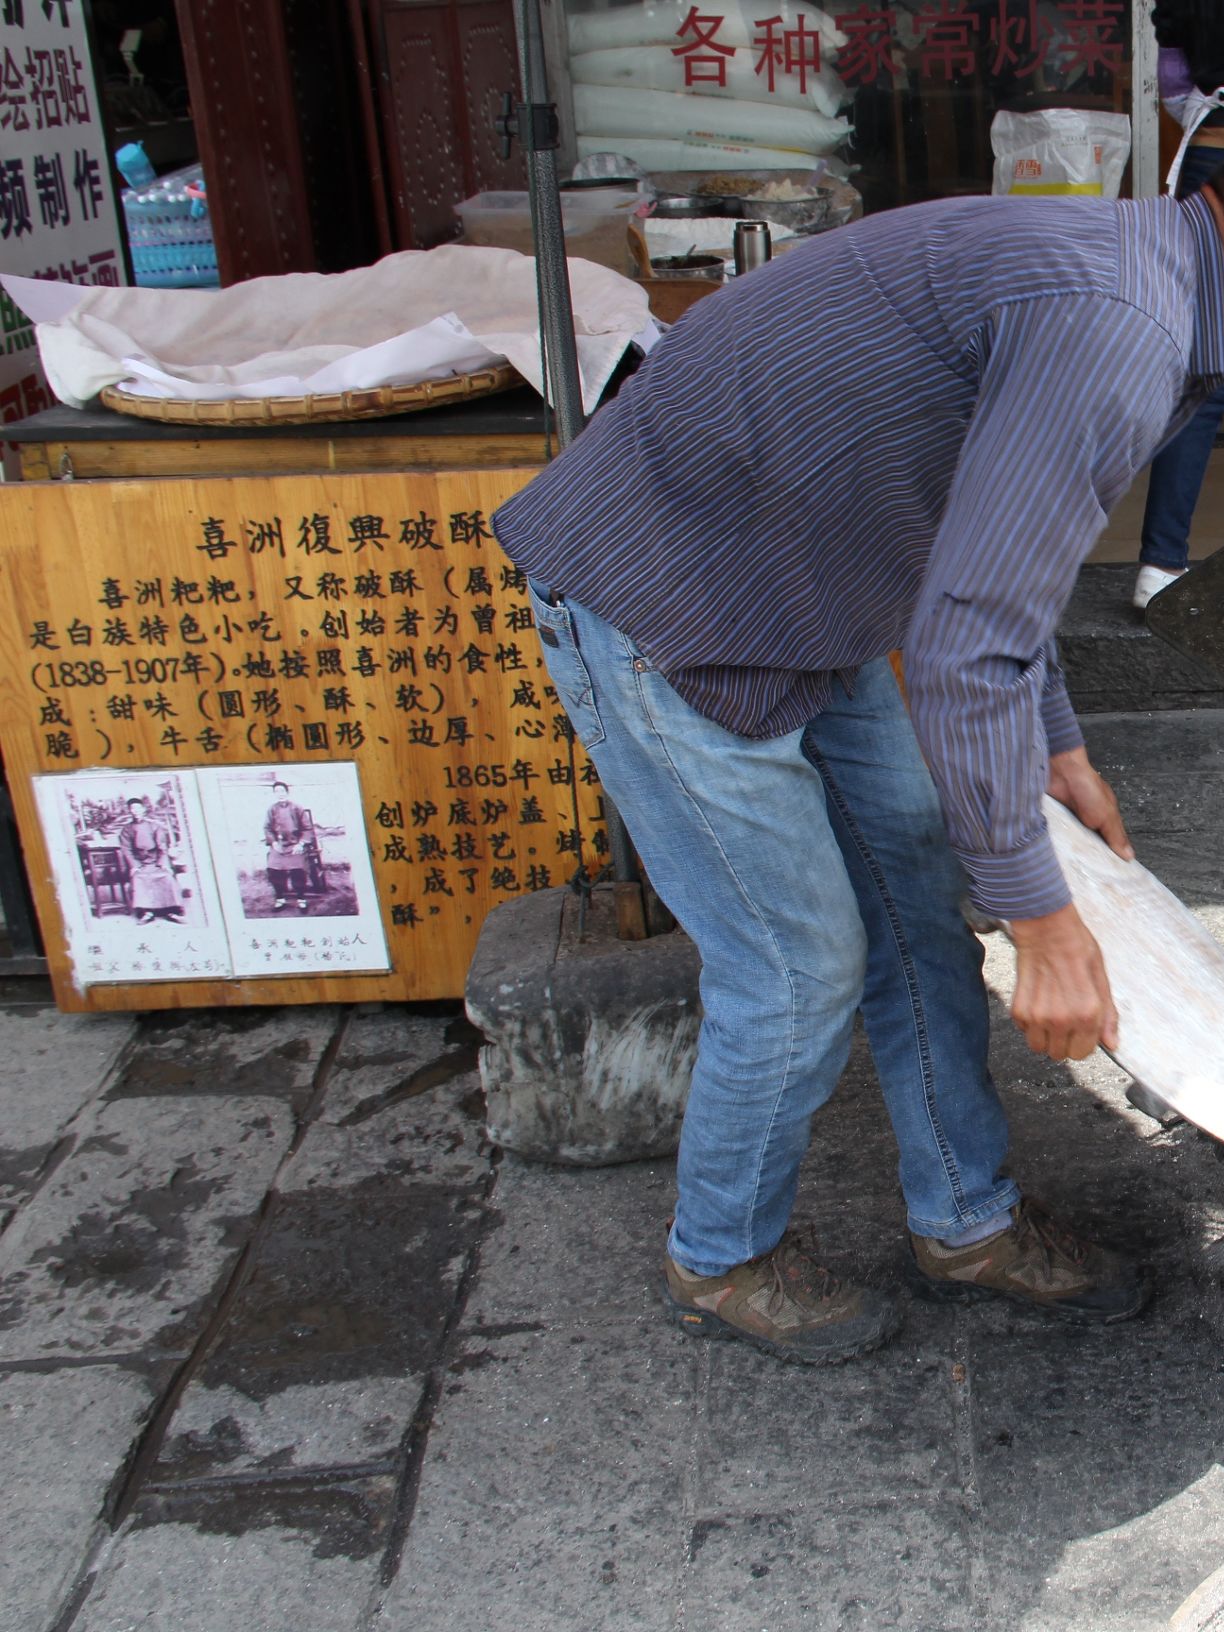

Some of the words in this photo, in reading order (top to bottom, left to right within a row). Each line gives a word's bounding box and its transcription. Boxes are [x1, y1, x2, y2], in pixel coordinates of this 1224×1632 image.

[671, 0, 1127, 94] 各种家常炒菜
[196, 509, 496, 560] 喜洲復興破酥
